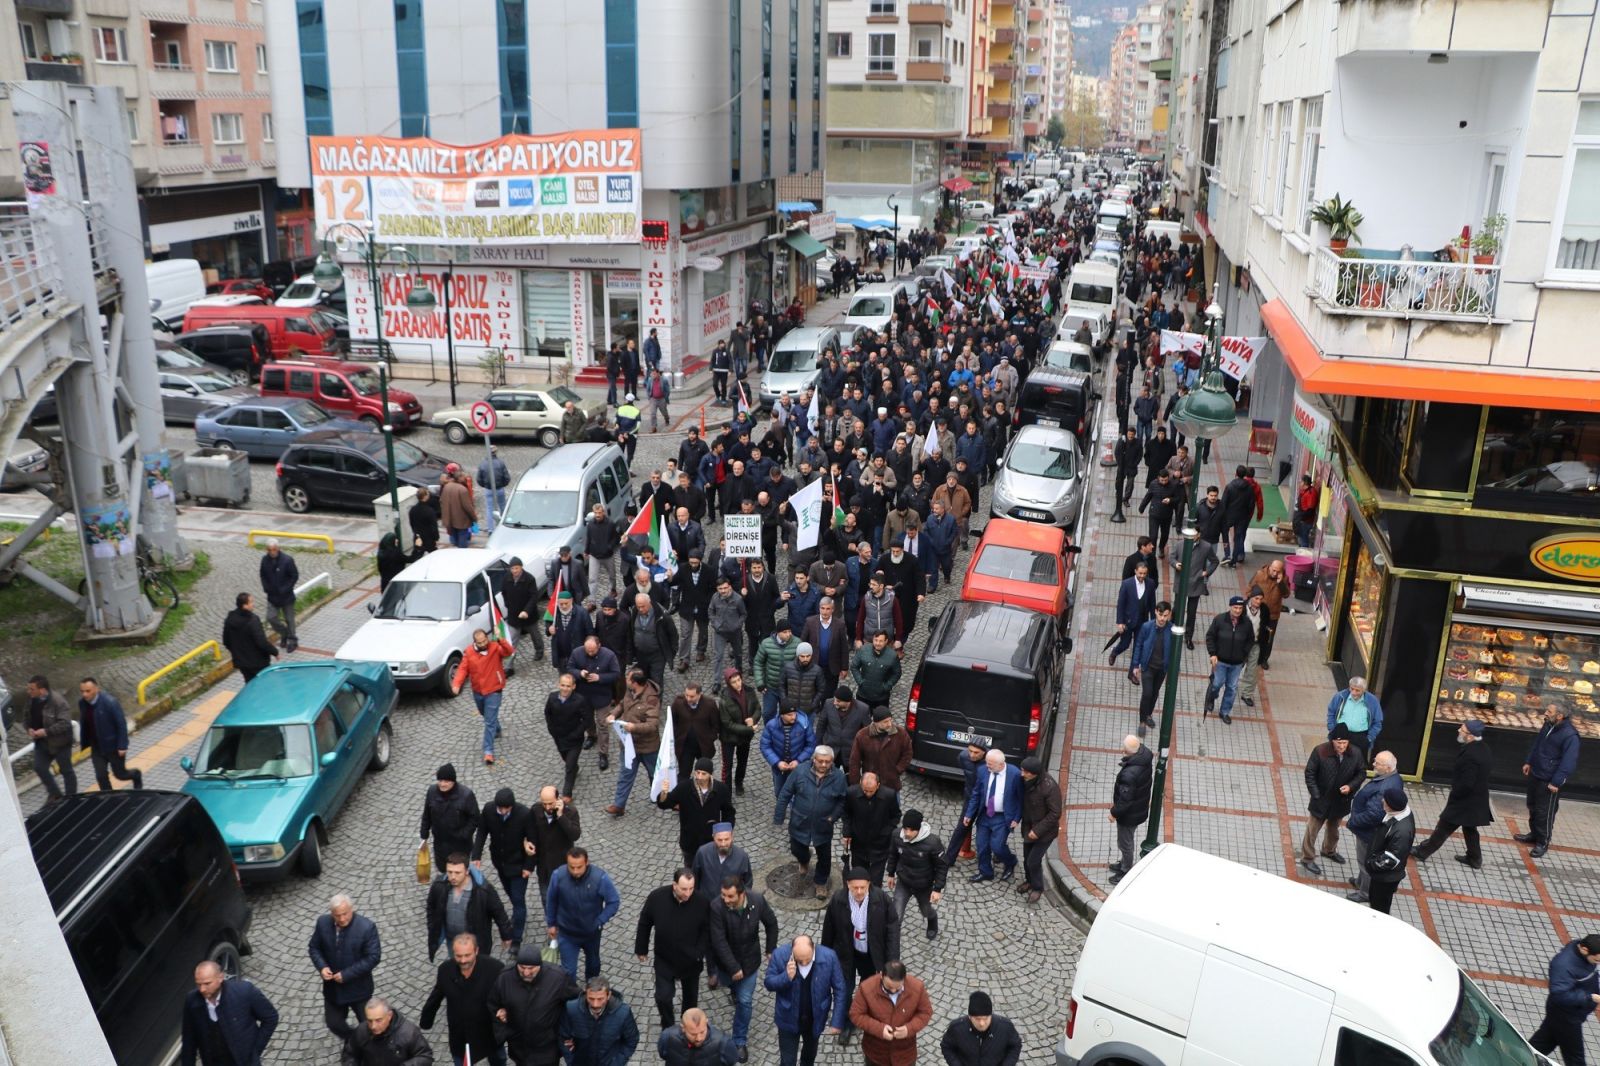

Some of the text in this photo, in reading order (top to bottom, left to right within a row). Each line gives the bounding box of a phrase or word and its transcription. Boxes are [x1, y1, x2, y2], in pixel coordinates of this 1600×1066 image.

[319, 137, 634, 174] MAĞAZAMIZI KAPATIYORUZ
[577, 178, 595, 191] OTEL
[610, 175, 630, 188] YURT
[319, 178, 365, 220] 12
[608, 188, 631, 201] HALISI
[377, 214, 444, 238] ZARARINA
[473, 247, 545, 261] SARAY HALI
[453, 312, 493, 348] SATIŞ
[1219, 336, 1254, 363] ANYA
[1228, 360, 1241, 376] TL
[726, 531, 760, 542] DİRENİŞE
[729, 545, 756, 554] DEVAM
[952, 731, 962, 740] 53
